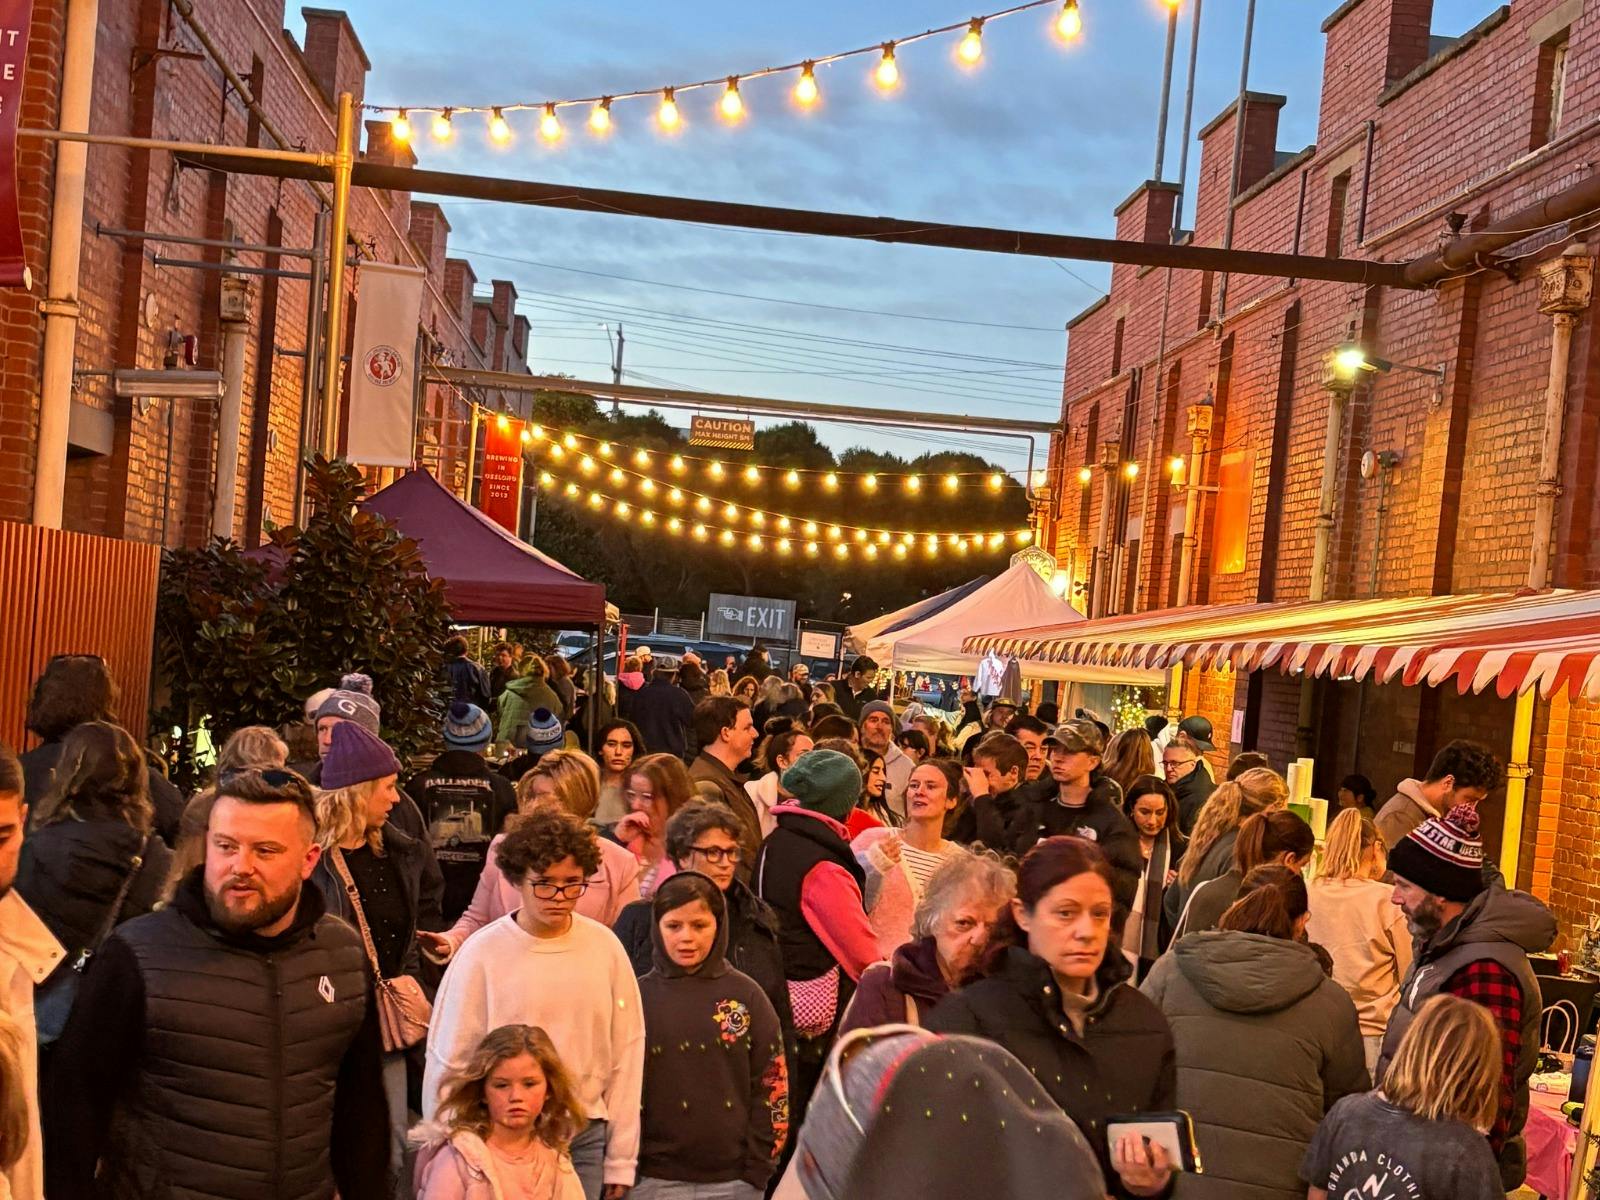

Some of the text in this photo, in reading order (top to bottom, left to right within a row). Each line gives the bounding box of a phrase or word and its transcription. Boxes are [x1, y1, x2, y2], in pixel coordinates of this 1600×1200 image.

[694, 430, 711, 438] MAX
[712, 432, 738, 440] HEIGHT
[695, 419, 751, 434] CAUTION
[486, 454, 519, 463] BREWING
[747, 606, 786, 630] EXIT
[338, 699, 358, 716] G
[1427, 828, 1457, 851] STAR
[1328, 1149, 1368, 1191] GHANDA
